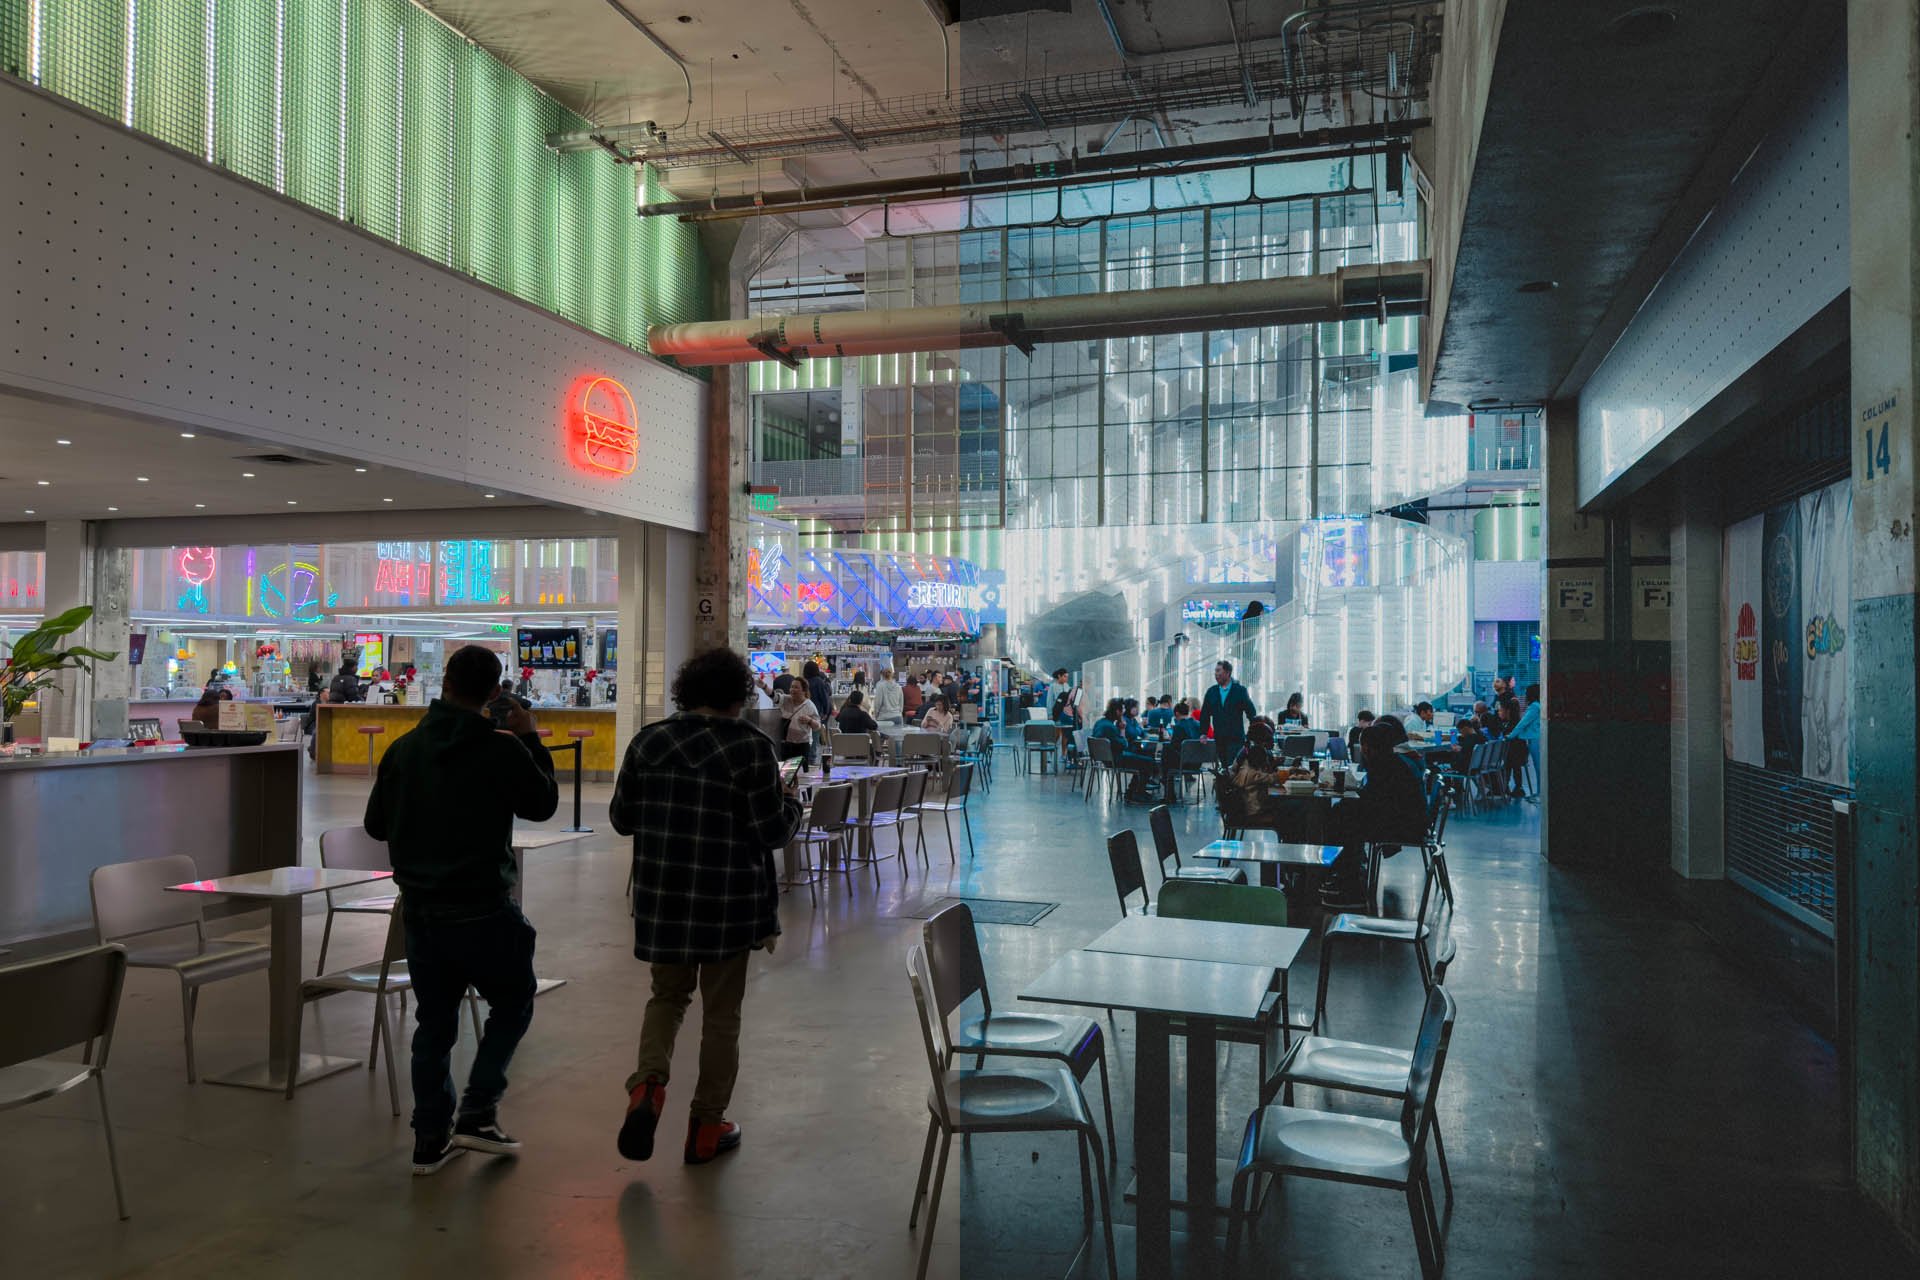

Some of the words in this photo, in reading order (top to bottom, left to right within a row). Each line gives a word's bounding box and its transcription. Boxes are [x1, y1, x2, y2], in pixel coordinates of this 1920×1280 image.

[1862, 397, 1896, 421] COLUMN
[1866, 422, 1891, 480] 14
[698, 598, 712, 614] G
[1182, 609, 1207, 619] Event
[1208, 609, 1236, 619] Venue
